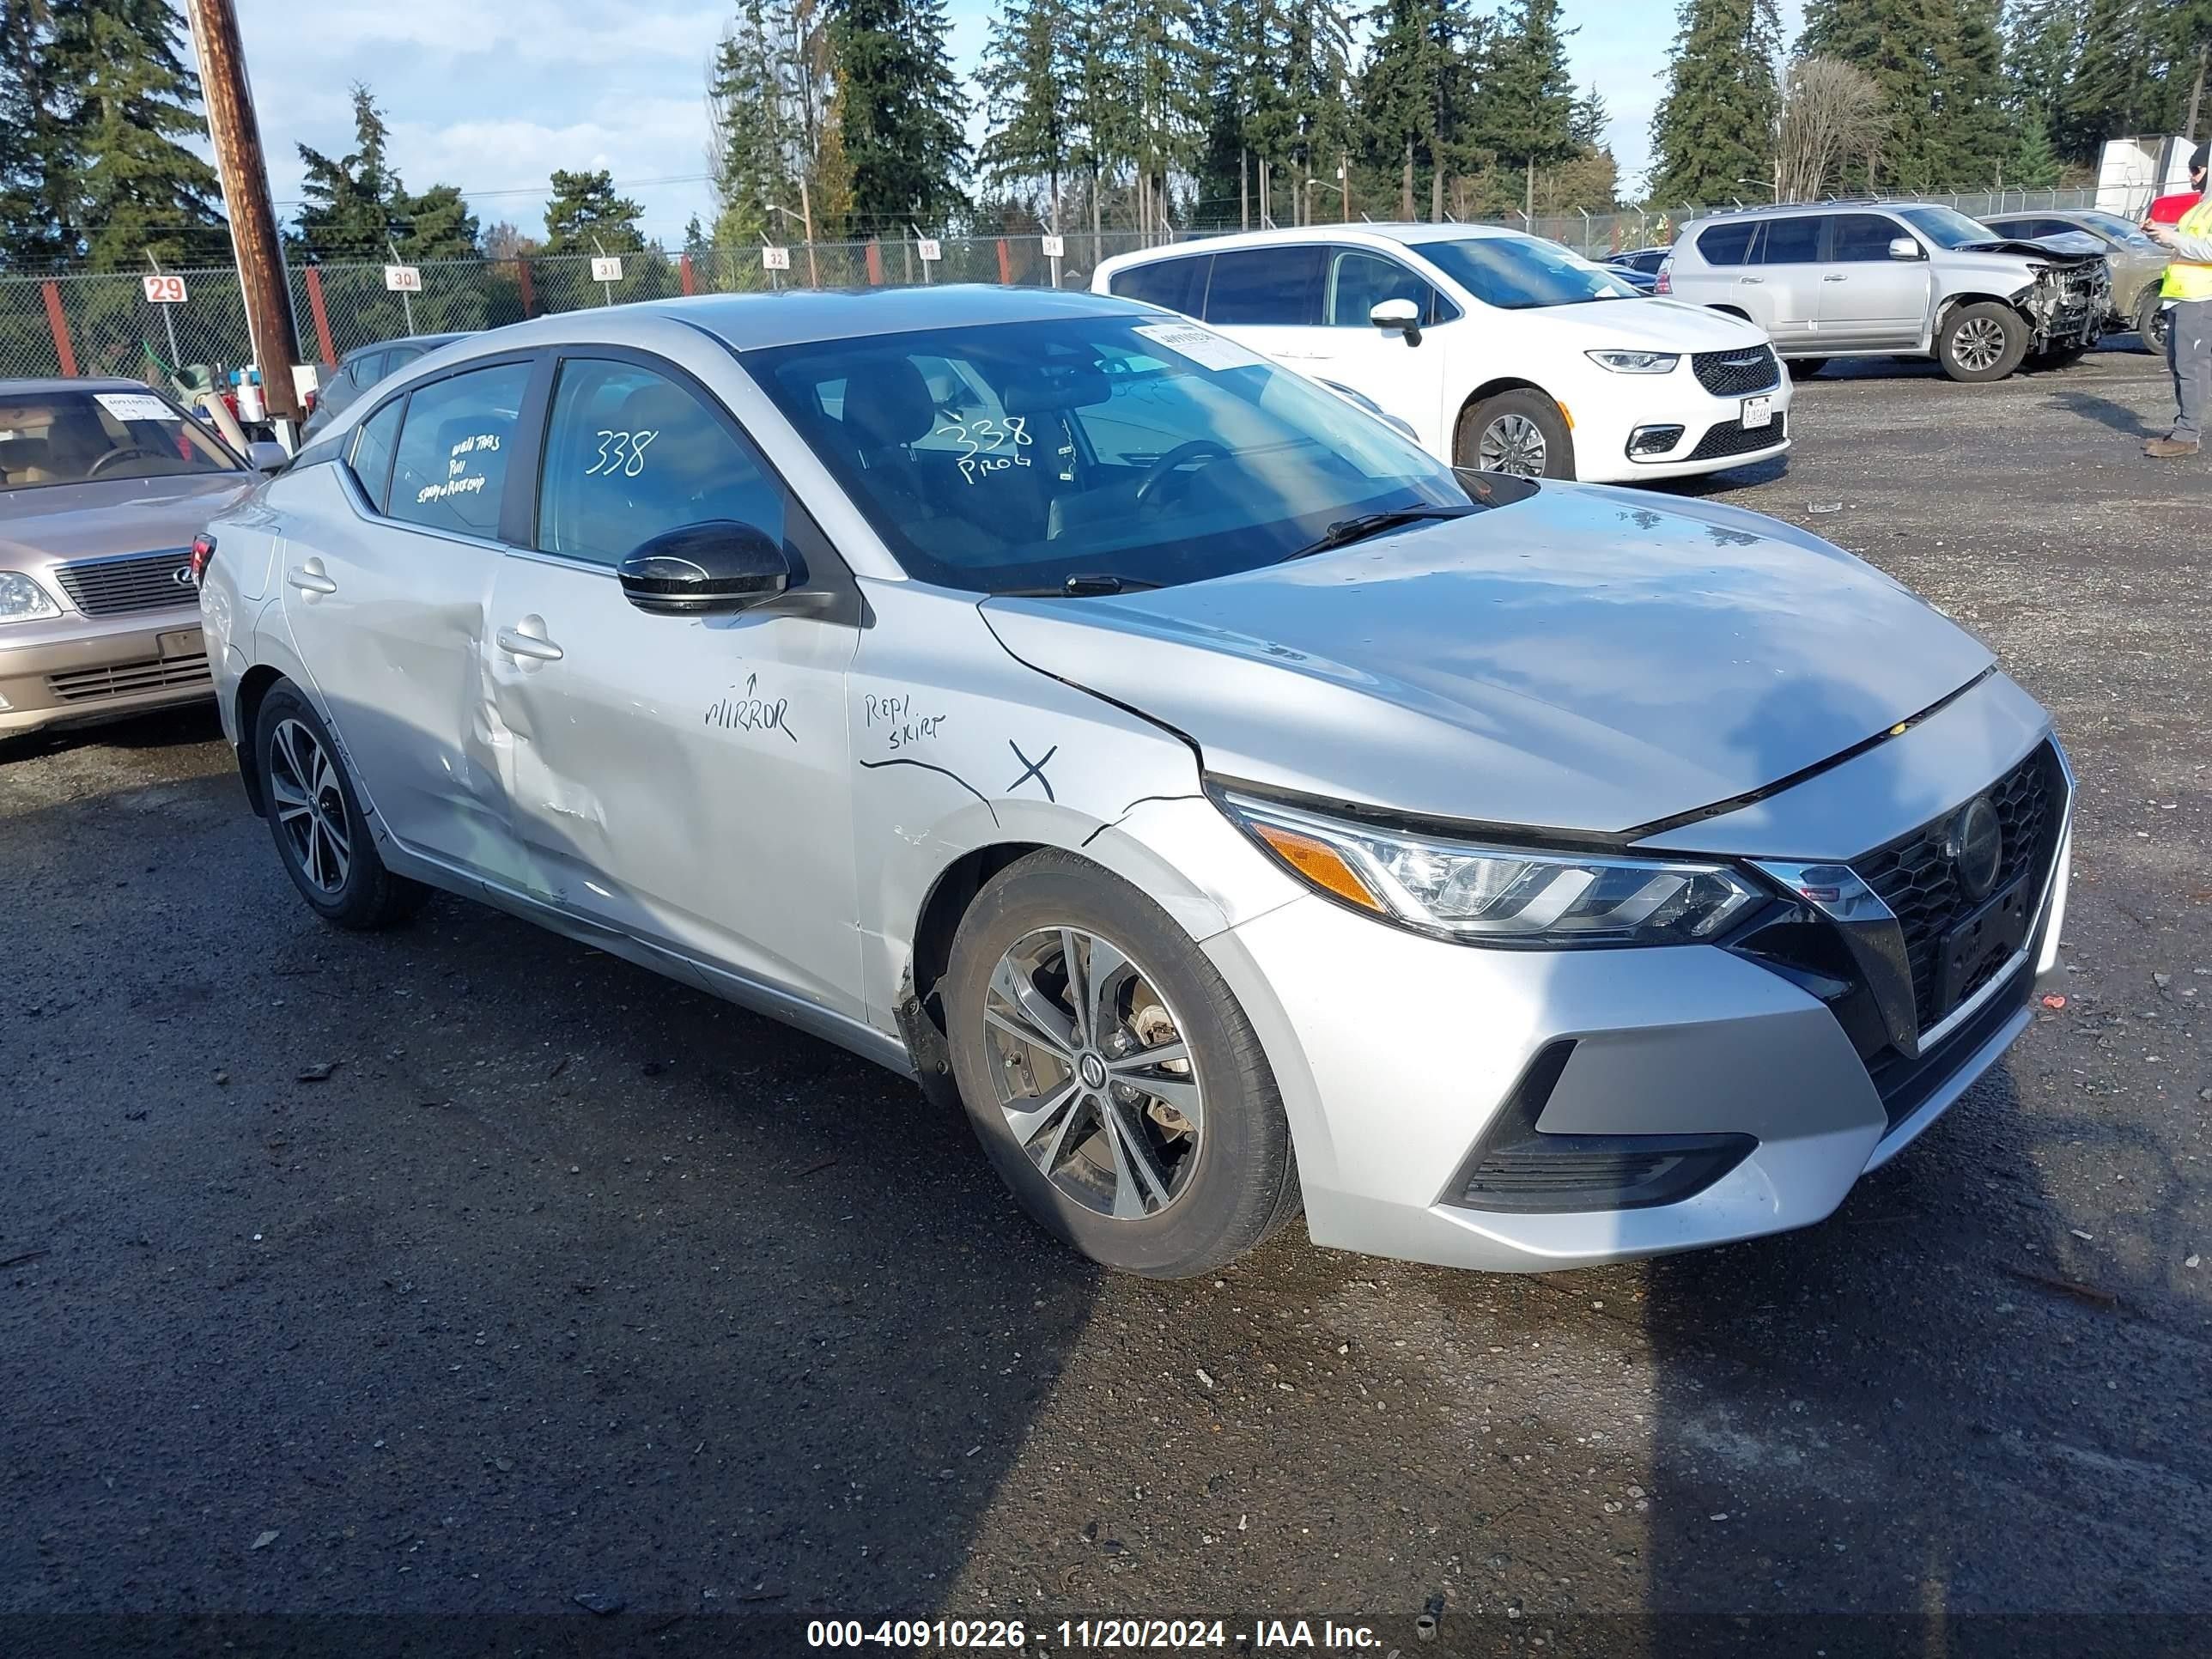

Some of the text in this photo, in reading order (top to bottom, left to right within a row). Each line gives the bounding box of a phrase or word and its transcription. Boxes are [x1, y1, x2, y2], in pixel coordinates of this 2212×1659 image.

[600, 264, 615, 276] 31
[770, 253, 783, 264] 32
[149, 278, 184, 301] 29
[394, 272, 412, 285] 30
[936, 416, 1032, 461] 338
[585, 430, 659, 477] 338
[957, 453, 1031, 484] PROG
[704, 697, 798, 743] MIRROR
